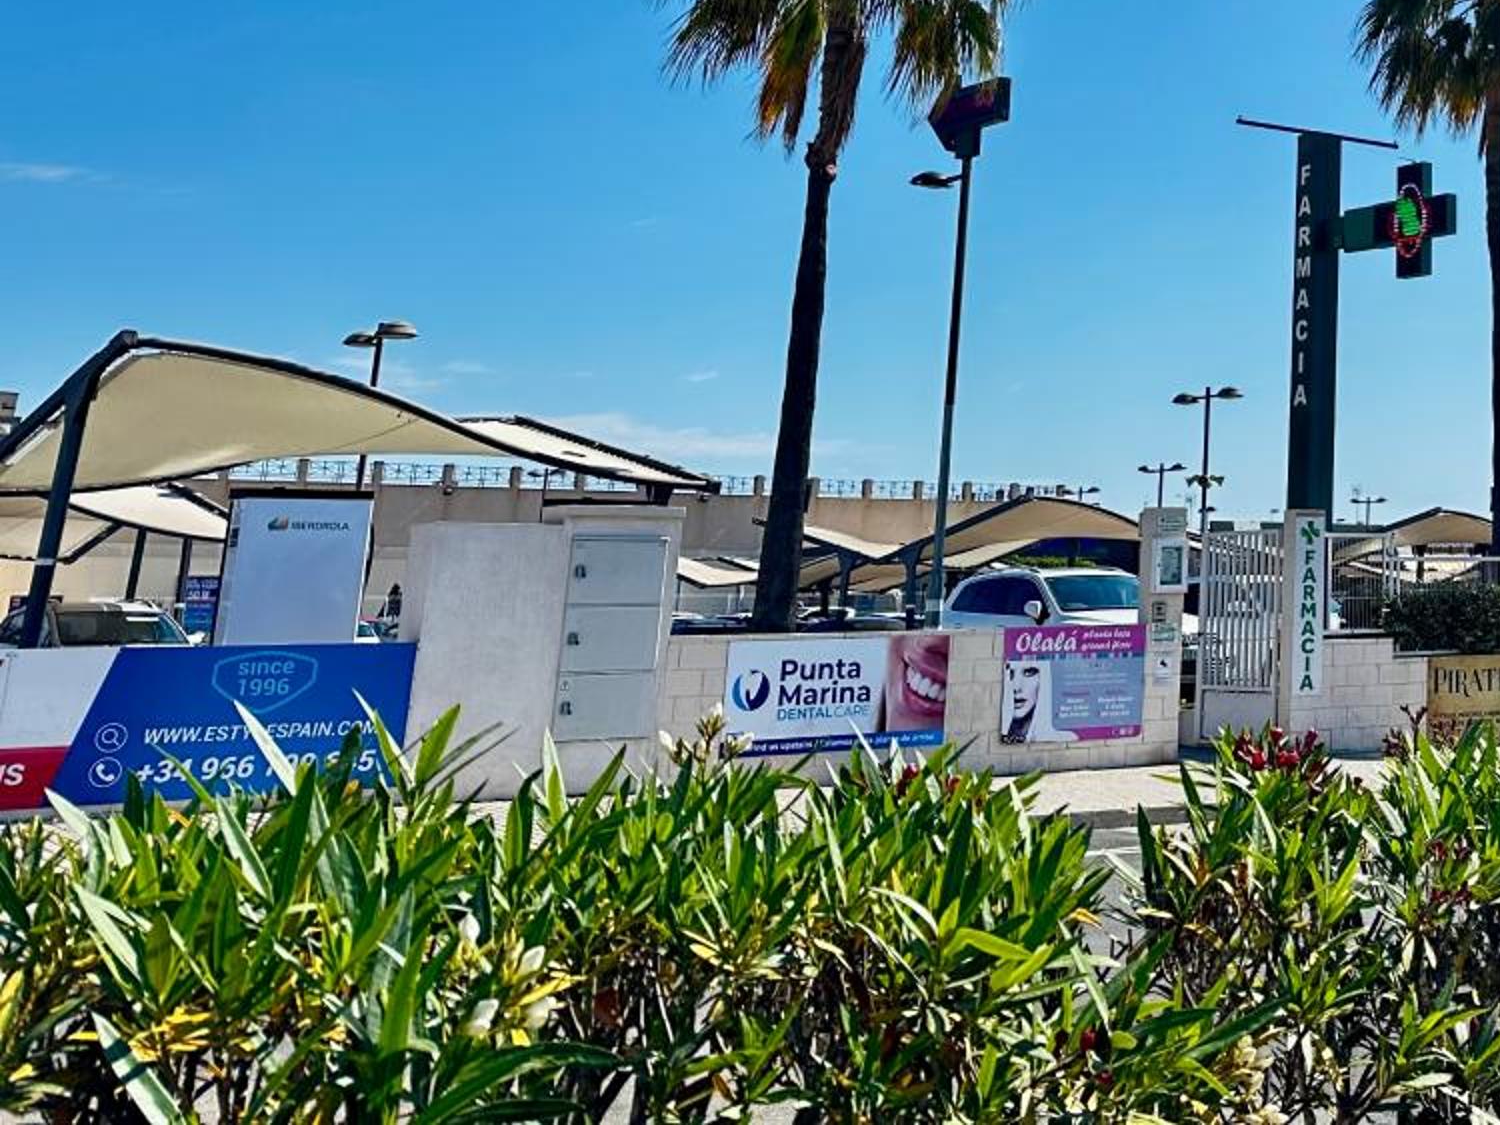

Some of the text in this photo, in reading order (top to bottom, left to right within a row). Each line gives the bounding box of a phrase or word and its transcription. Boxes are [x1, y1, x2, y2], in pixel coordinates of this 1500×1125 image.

[1293, 164, 1312, 407] FARMACIA
[1300, 549, 1317, 691] FARMACIA
[1015, 631, 1077, 652] Olalá
[238, 660, 296, 676] since
[780, 659, 861, 682] Punta
[239, 678, 289, 696] 1996
[778, 680, 871, 707] Marina
[776, 707, 832, 721] DENTAL
[199, 754, 256, 781] 966
